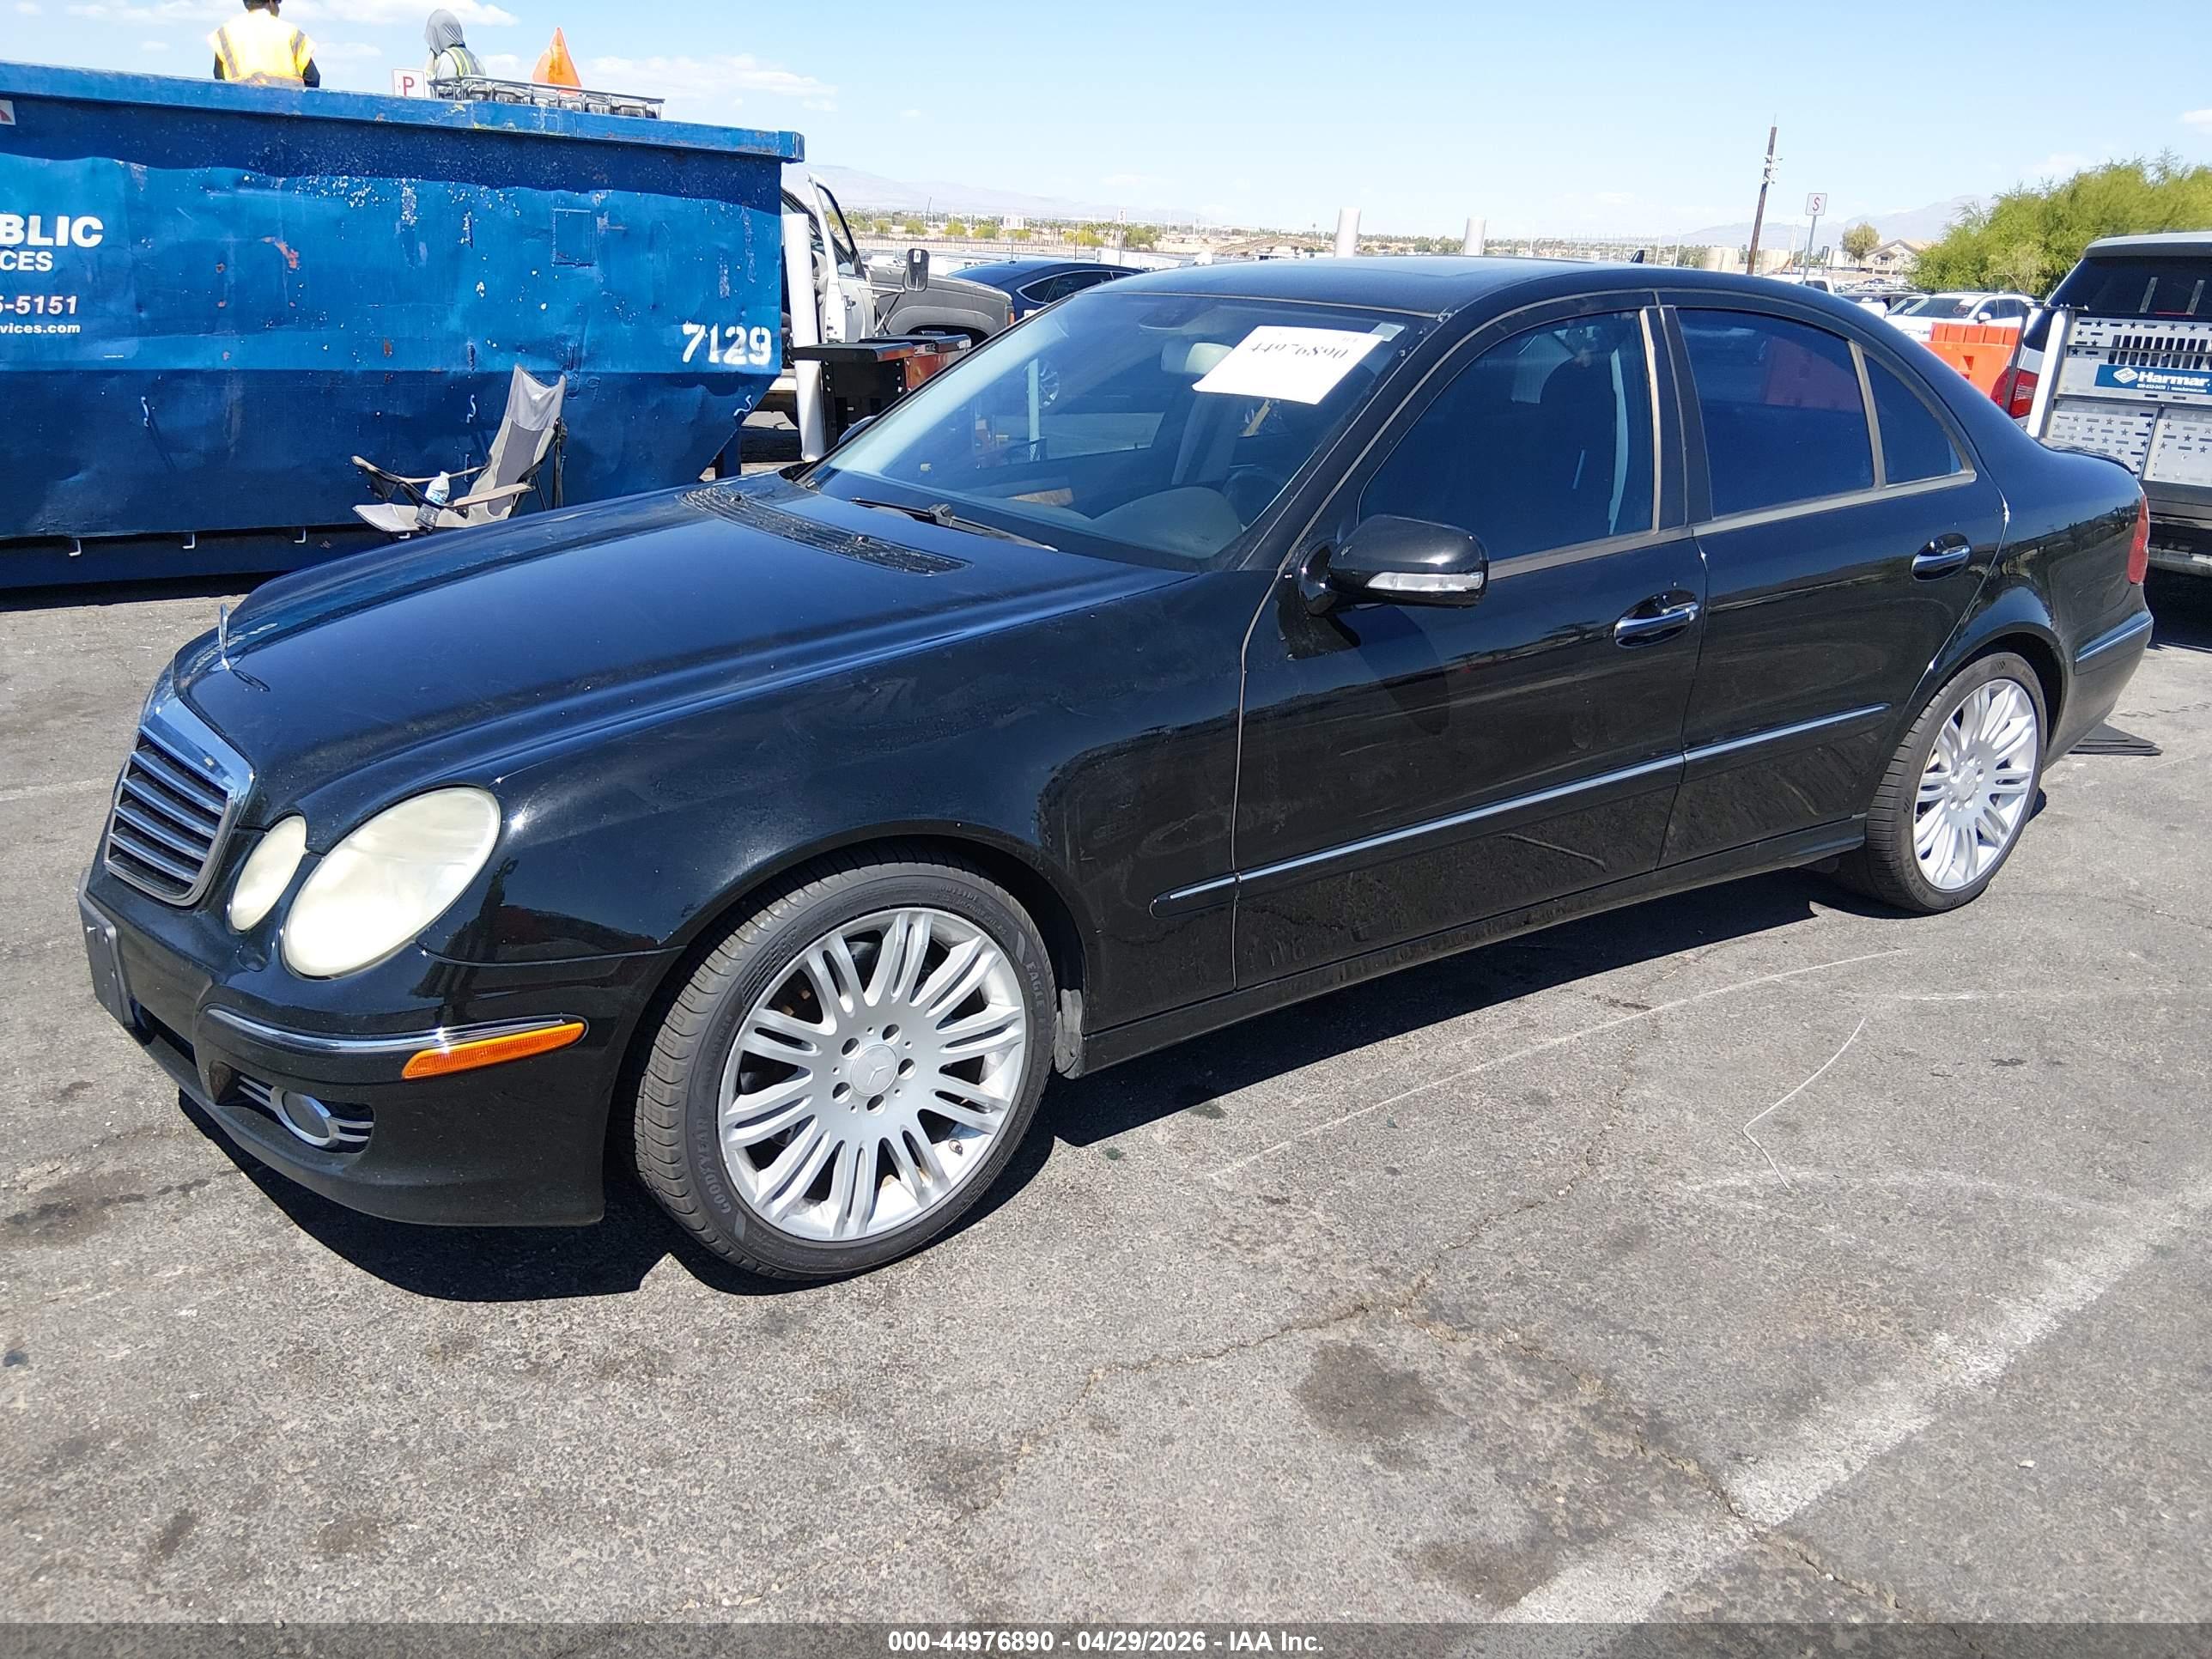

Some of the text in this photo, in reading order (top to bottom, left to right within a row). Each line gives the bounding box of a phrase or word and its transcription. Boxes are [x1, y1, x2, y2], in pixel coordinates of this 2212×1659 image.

[403, 76, 415, 96] P
[1812, 197, 1820, 211] S
[0, 214, 104, 247] BLIC
[0, 250, 53, 271] CES
[0, 295, 77, 314] -5151
[682, 323, 772, 366] 7129
[1025, 961, 1047, 1008] EAGLE
[695, 1117, 732, 1214] GOODYEAR
